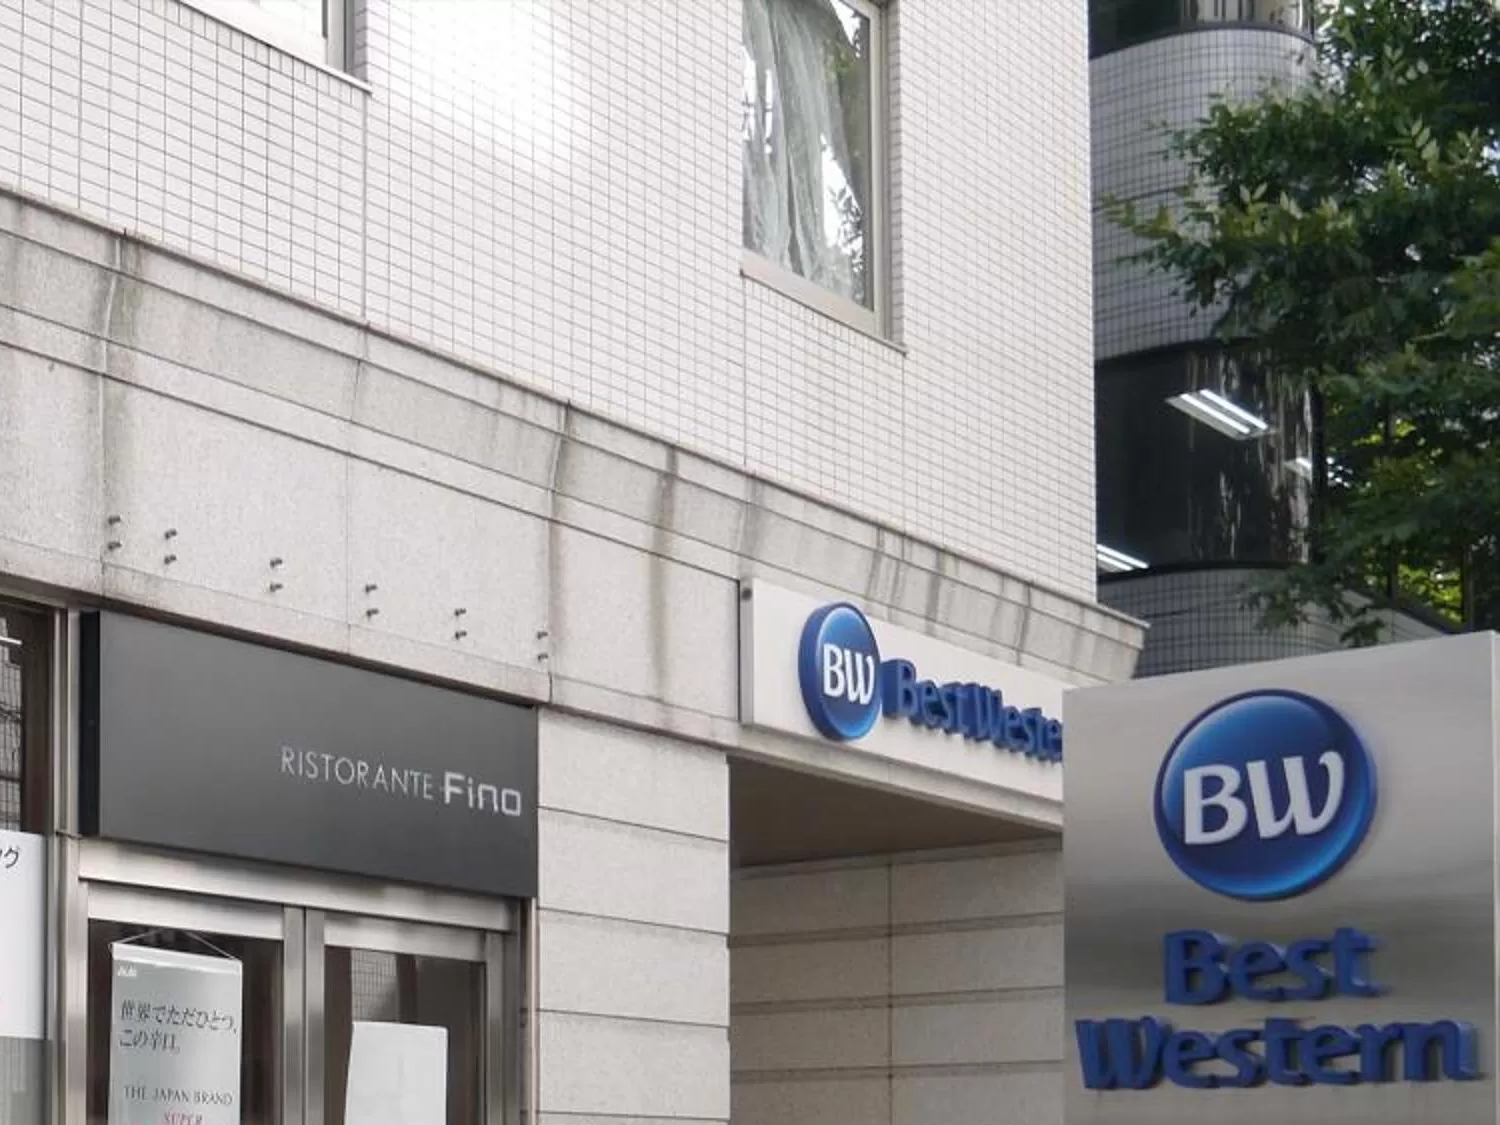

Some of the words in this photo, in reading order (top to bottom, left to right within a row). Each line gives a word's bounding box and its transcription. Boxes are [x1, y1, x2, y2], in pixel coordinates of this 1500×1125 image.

[823, 643, 876, 706] BW
[880, 658, 969, 737] Best
[280, 745, 434, 801] RISTORANTE
[443, 771, 522, 817] Fino
[1183, 750, 1346, 846] BW
[1162, 926, 1382, 1006] Best
[1074, 1015, 1480, 1090] Western
[123, 1084, 148, 1101] THE
[152, 1085, 190, 1104] JAPAN
